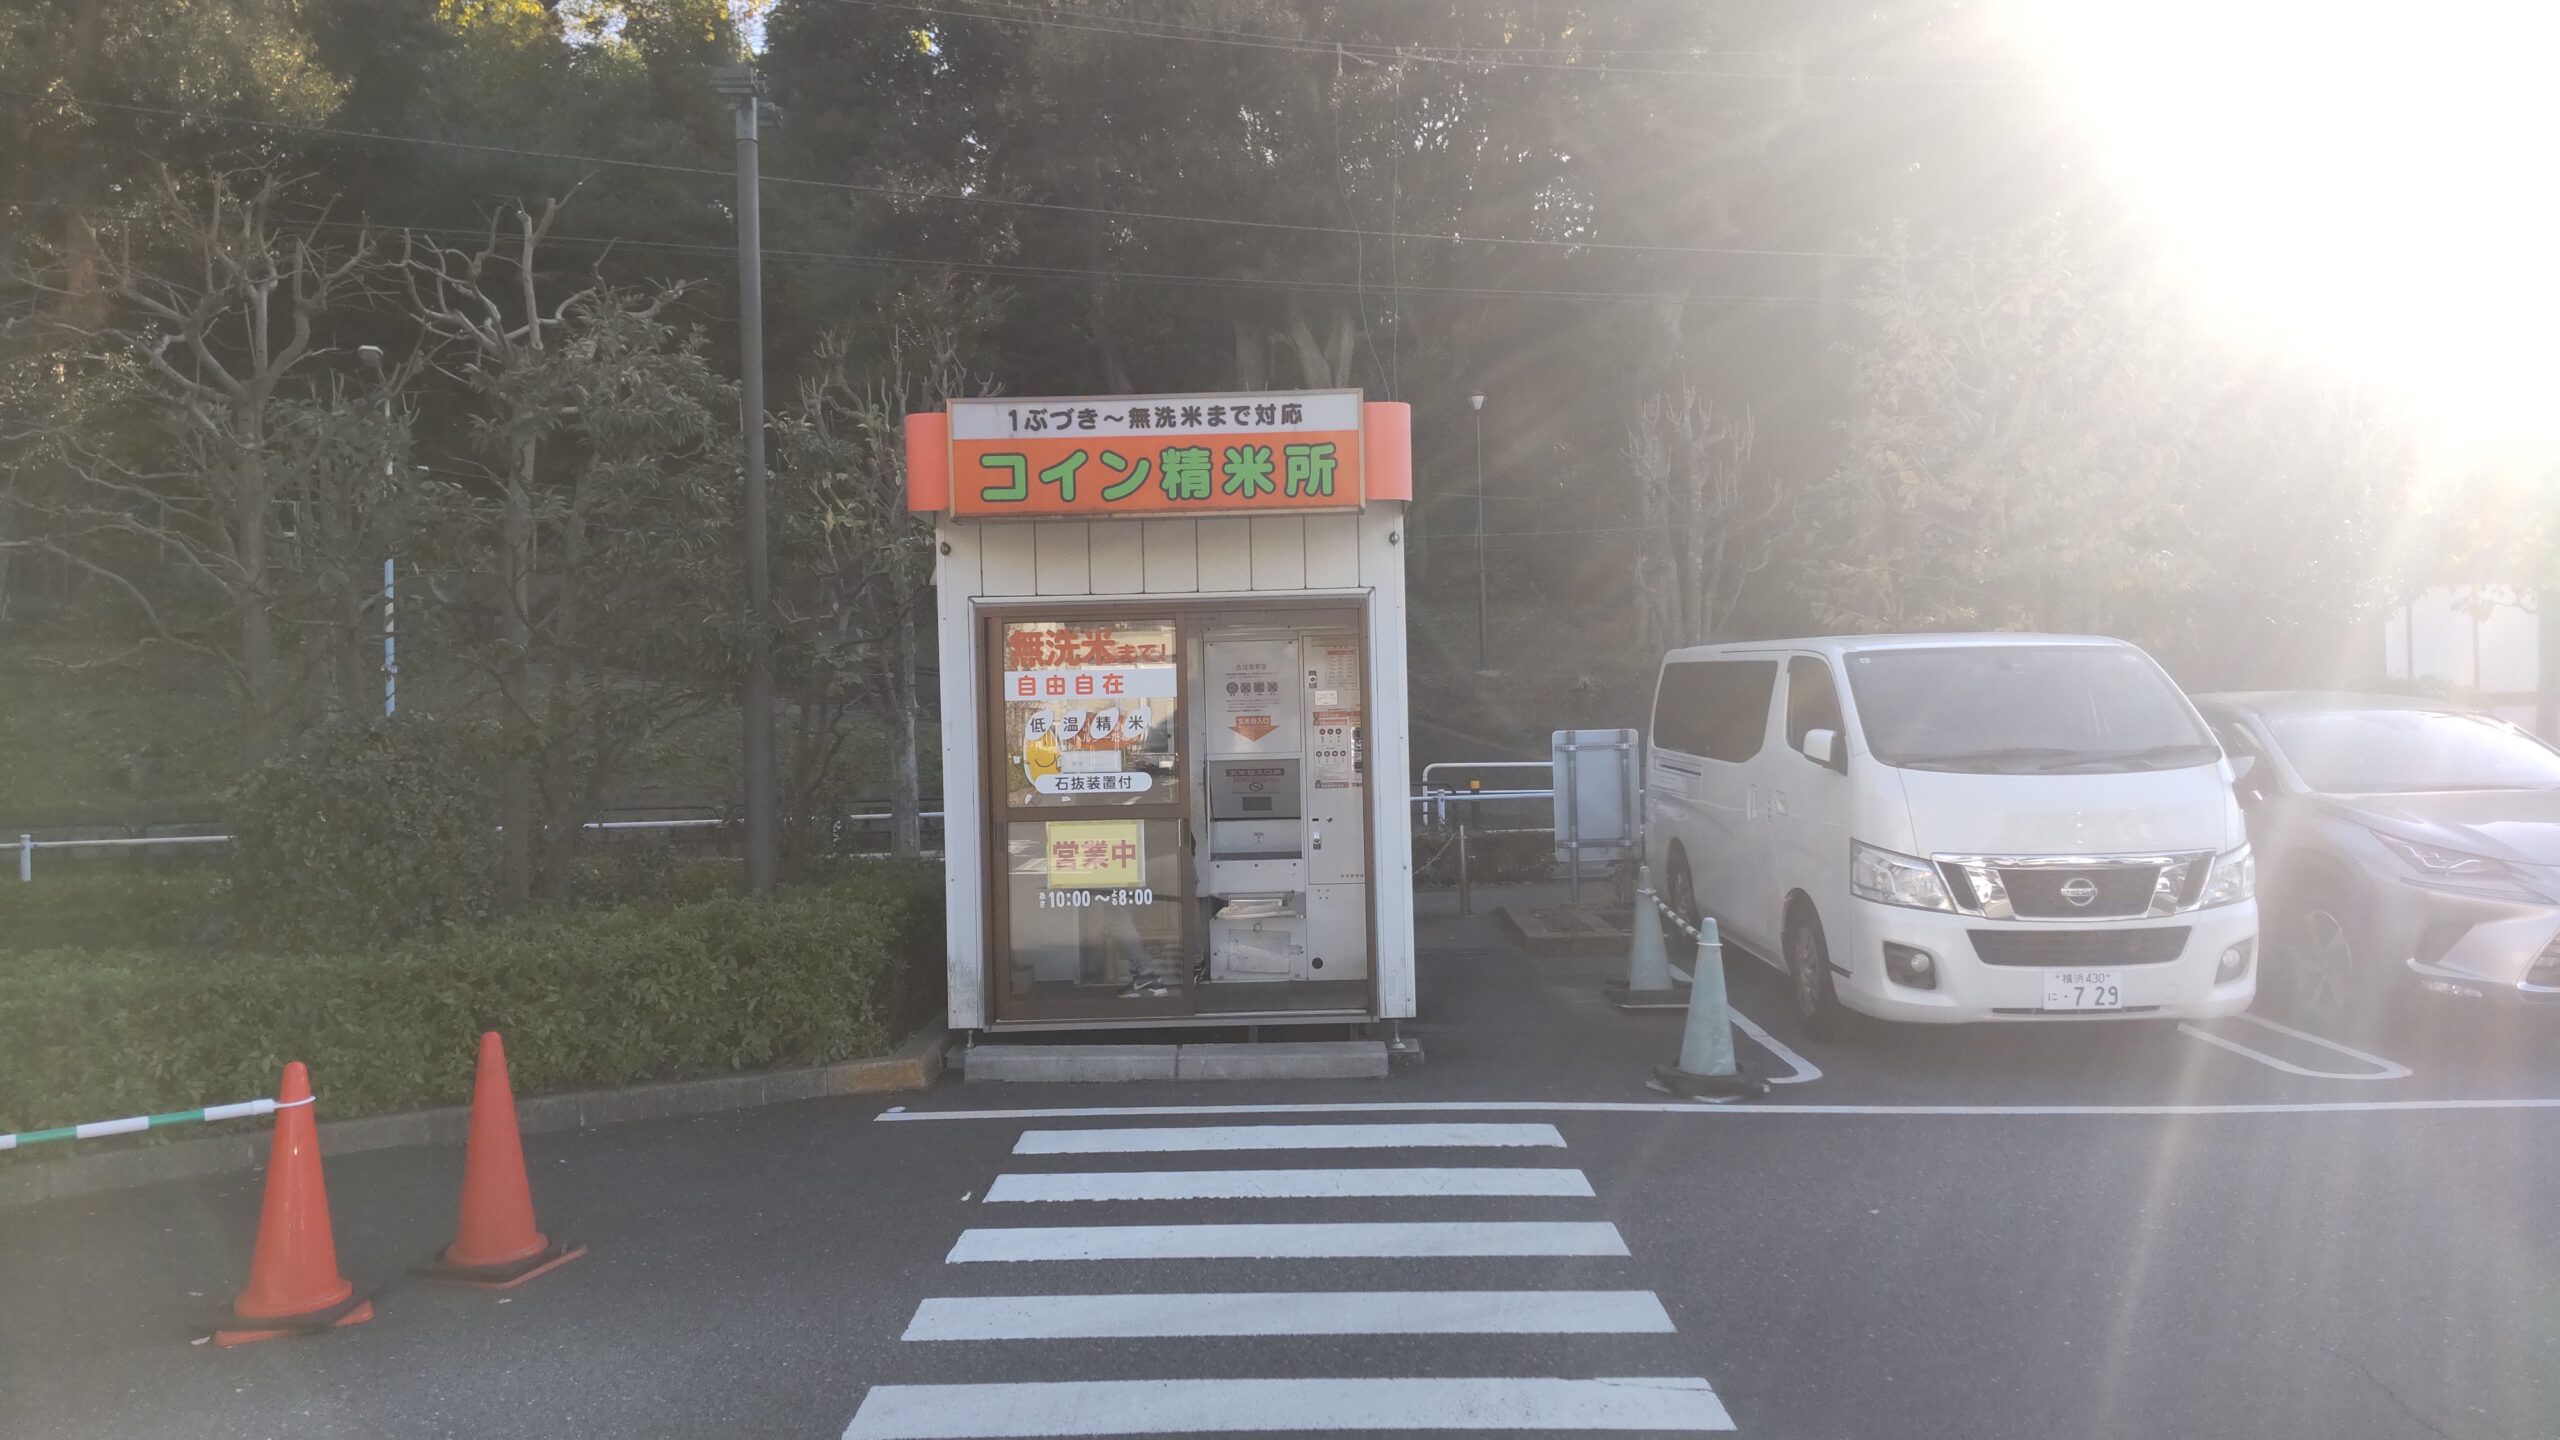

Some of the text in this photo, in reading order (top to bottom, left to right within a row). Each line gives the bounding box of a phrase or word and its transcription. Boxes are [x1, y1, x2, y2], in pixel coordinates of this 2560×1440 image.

[979, 442, 1338, 502] コイン精米所
[1018, 674, 1124, 696] 自由自在
[1030, 715, 1144, 733] 低温精米
[1055, 775, 1133, 791] 石抜装置付
[1052, 839, 1137, 871] 営業中
